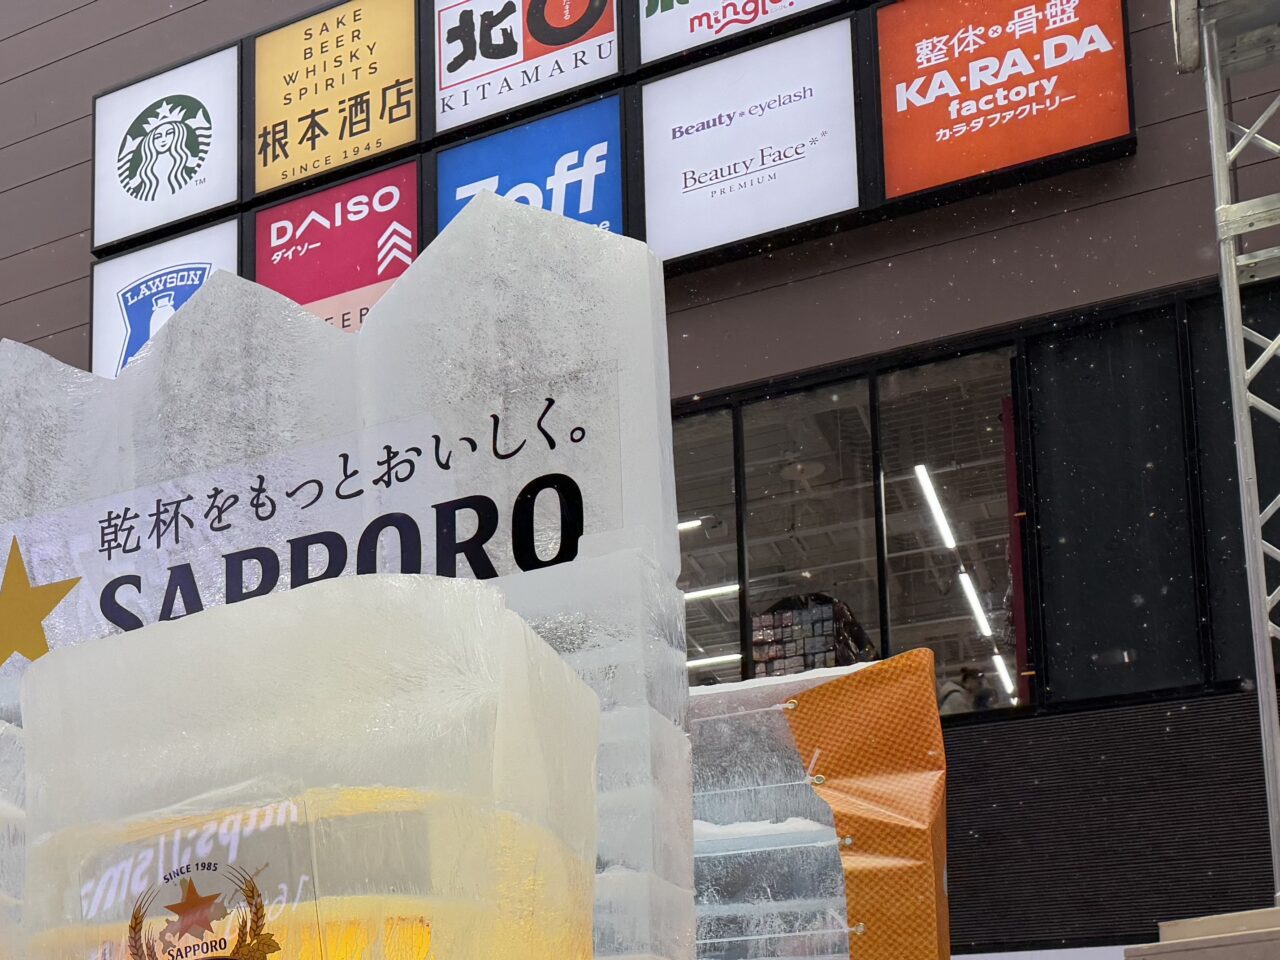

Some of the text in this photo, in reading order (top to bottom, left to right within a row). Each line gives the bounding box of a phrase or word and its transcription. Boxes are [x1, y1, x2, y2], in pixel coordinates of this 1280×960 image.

[303, 9, 362, 41] SAKE
[303, 29, 361, 60] BEER
[283, 42, 377, 86] WHISKY
[283, 62, 378, 106] SPIRITS
[439, 40, 615, 114] KITAMARU
[671, 86, 814, 140] Beauty eyelash
[948, 75, 1059, 120] factory
[257, 78, 414, 168] 根本酒店
[282, 138, 383, 180] SINCE 1945
[682, 142, 806, 190] Beauty Face
[710, 172, 778, 198] PREMIUM
[270, 185, 401, 248] DAISO
[271, 241, 322, 265] ダイソー
[126, 269, 202, 306] LAWSON
[97, 397, 587, 561] 乾杯をもっとおいしく。
[162, 861, 219, 884] SINCE 1985
